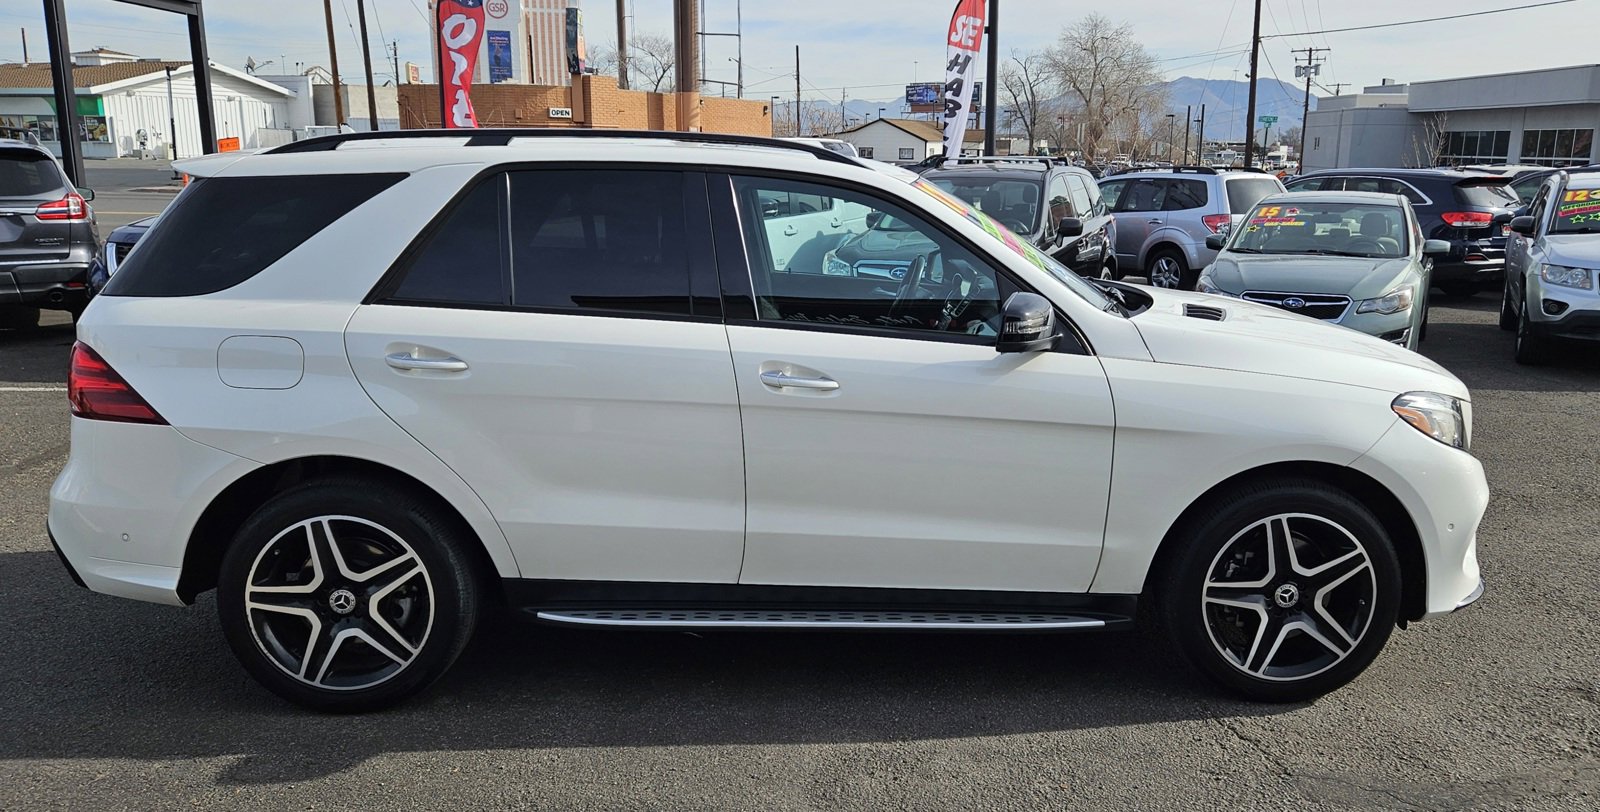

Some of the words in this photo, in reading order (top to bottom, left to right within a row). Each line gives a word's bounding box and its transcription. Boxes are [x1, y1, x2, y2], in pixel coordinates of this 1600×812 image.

[488, 3, 505, 13] GSR
[951, 14, 981, 47] SE
[1564, 190, 1588, 201] 12
[1257, 206, 1281, 217] 15
